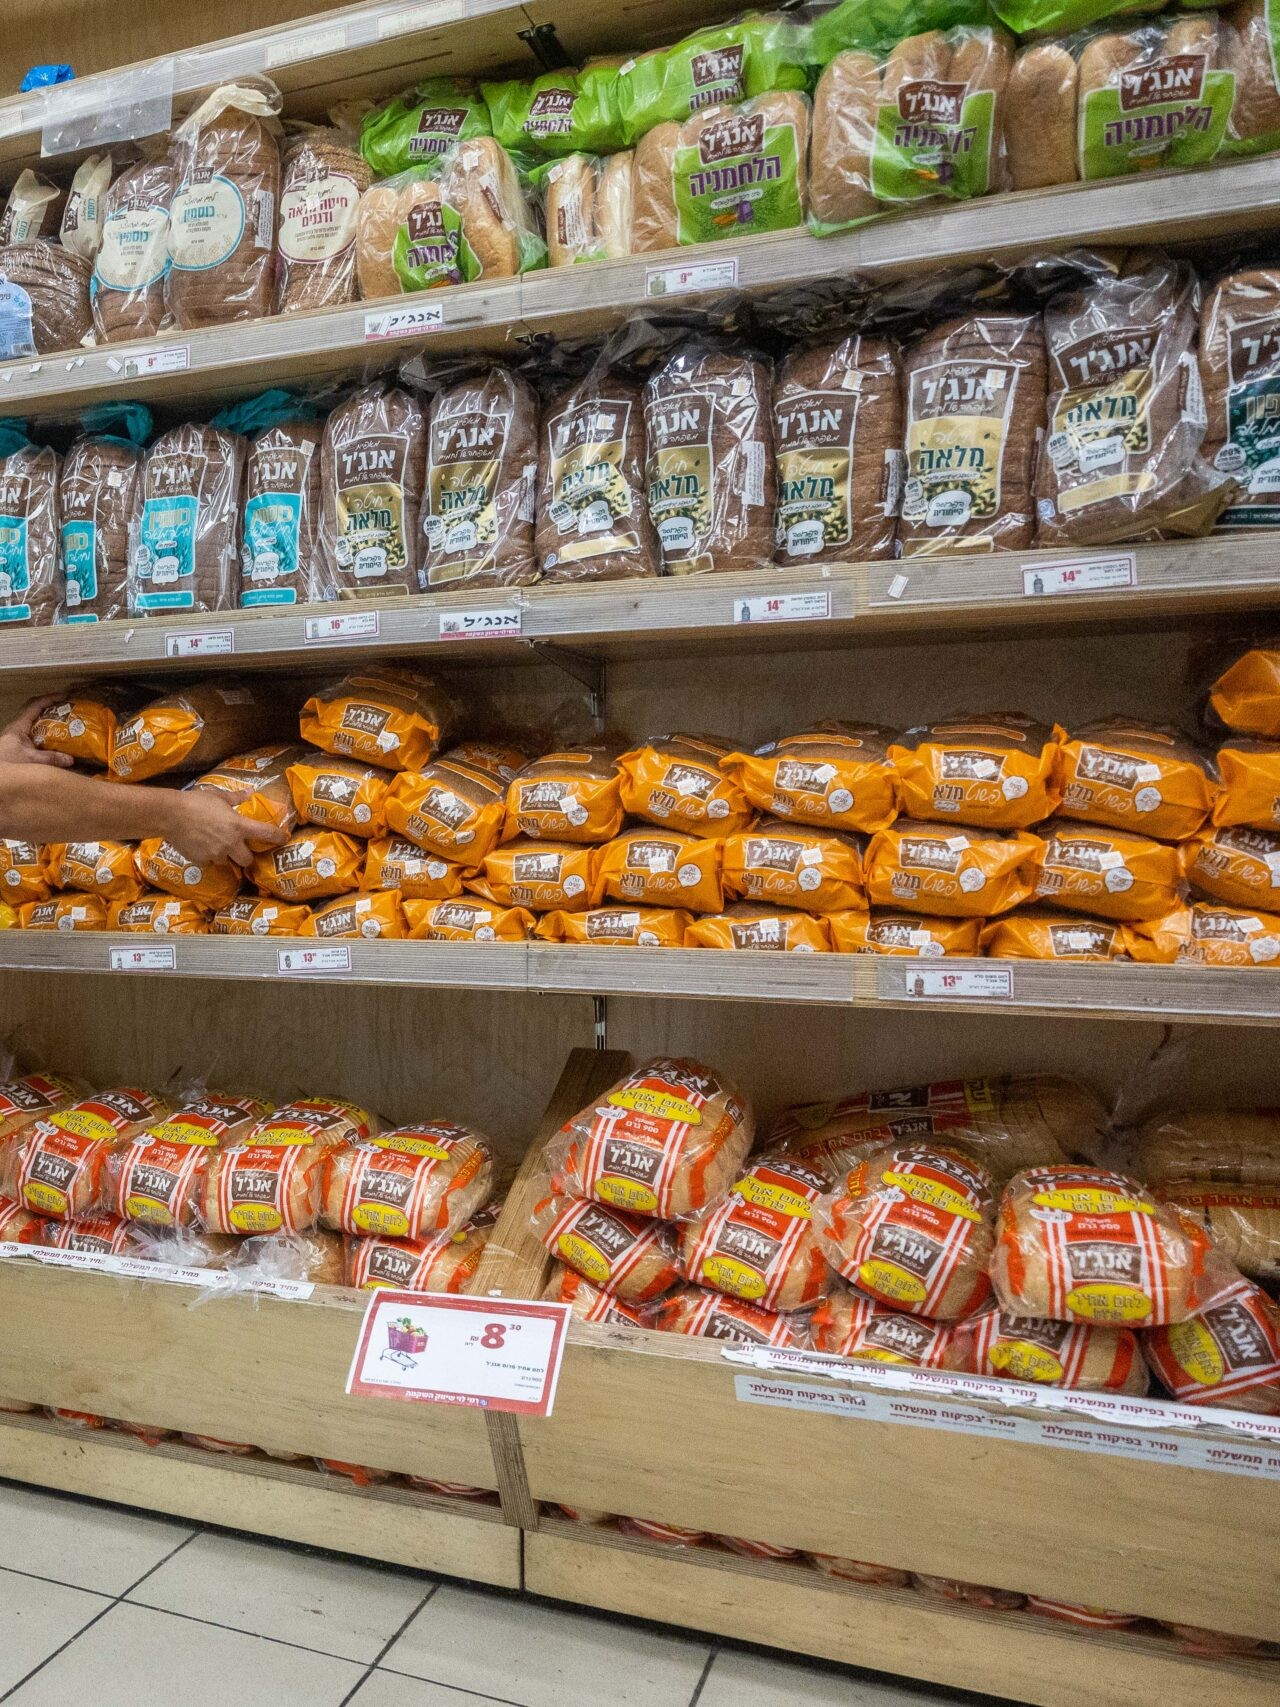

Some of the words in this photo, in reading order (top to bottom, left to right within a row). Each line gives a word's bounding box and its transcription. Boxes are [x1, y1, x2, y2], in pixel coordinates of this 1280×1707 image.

[1122, 67, 1194, 97] אנג'ל
[905, 90, 958, 114] אנג'ל
[424, 115, 459, 128] אנג'ל
[1105, 105, 1213, 146] הלחמניה
[705, 125, 757, 151] אנג'ל
[689, 156, 782, 197] הלחמניה
[1070, 337, 1150, 381] אנג'ל
[922, 376, 997, 402] אנג'ל
[777, 409, 842, 439] אנג'ל
[438, 428, 495, 450] אנג'ל
[343, 450, 395, 474] אנג'ל
[920, 446, 984, 470] מלאה
[153, 466, 194, 487] אנג'ל
[561, 462, 610, 493] מלאה
[650, 473, 699, 500] מלאה
[441, 485, 485, 510] מלאה
[347, 509, 391, 530] מלאה
[349, 708, 384, 726] אנג'ל
[333, 730, 355, 747] מלא
[1086, 753, 1136, 779] אנג'ל
[933, 784, 964, 800] מלא
[753, 844, 794, 862] אנג'ל
[620, 873, 645, 888] מלא
[891, 871, 920, 889] מלא
[320, 914, 352, 934] אנג'ל
[661, 1099, 695, 1115] לחם
[611, 1146, 654, 1172] אנג'ל
[37, 1159, 69, 1181] אנג'ל
[137, 1171, 170, 1192] אנג'ל
[236, 1176, 271, 1192] אנג'ל
[368, 1175, 406, 1197] אנג'ל
[586, 1213, 625, 1248] אנג'ל
[726, 1229, 770, 1259] אנג'ל
[878, 1229, 932, 1264] אנג'ל
[375, 1252, 411, 1276] אנג'ל
[1073, 1248, 1133, 1269] אנג'ל
[481, 1323, 506, 1349] 8
[1223, 1306, 1261, 1359] אנג'ל
[749, 1382, 793, 1396] ממשלתי
[910, 1371, 958, 1386] ממשלתי
[962, 1378, 1004, 1393] בפיקוח
[797, 1389, 835, 1402] בפיקוח
[1064, 1394, 1116, 1409] ממשלתי
[890, 1402, 937, 1416] ממשלתי
[1120, 1404, 1165, 1417] בפיקוח
[1170, 1411, 1202, 1423] מחיר
[1042, 1424, 1093, 1439] ממשלתי
[1097, 1432, 1142, 1446] בפיקוח
[1147, 1440, 1178, 1451] מחיר
[1206, 1448, 1263, 1465] ממשלתי
